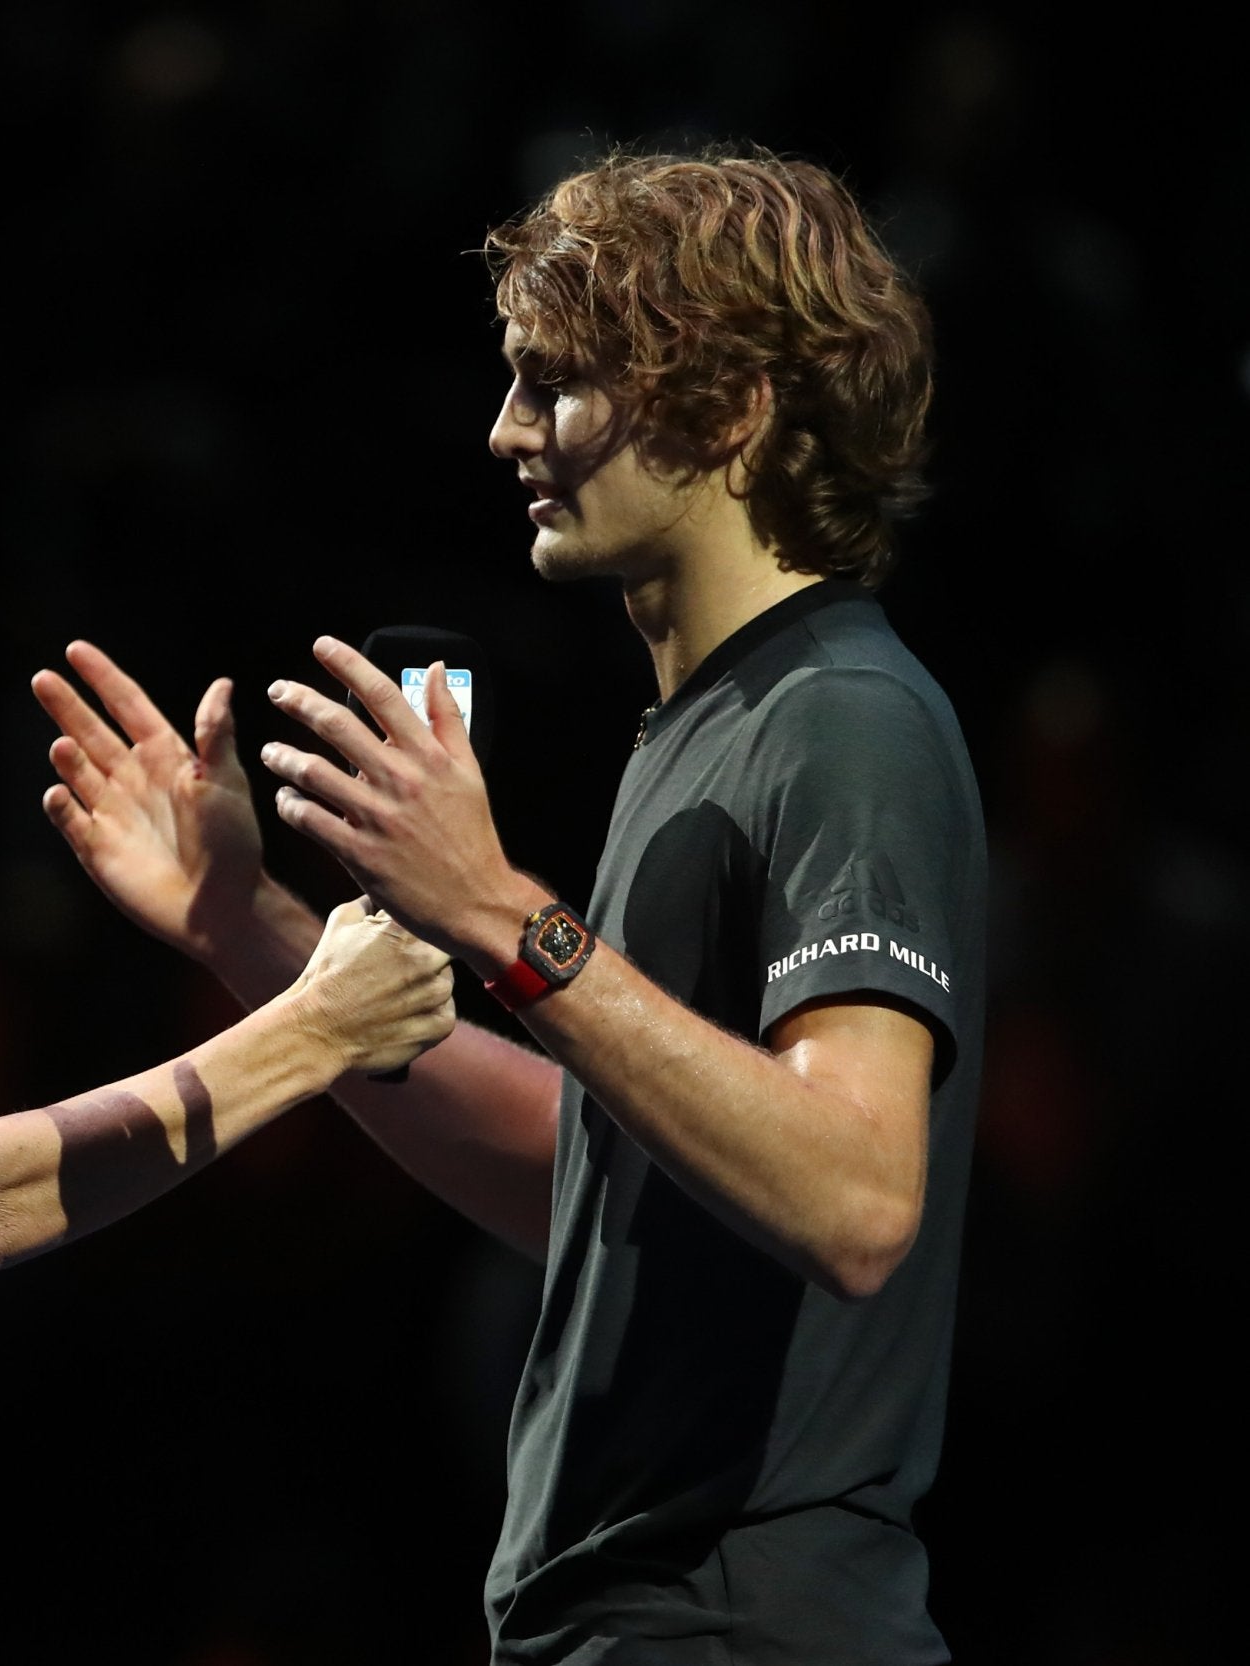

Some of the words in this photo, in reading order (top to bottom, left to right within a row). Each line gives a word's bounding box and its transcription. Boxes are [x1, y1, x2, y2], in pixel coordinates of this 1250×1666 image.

[408, 671, 465, 686] Nto
[767, 932, 880, 983] RICHARD
[889, 940, 950, 993] MILLE
